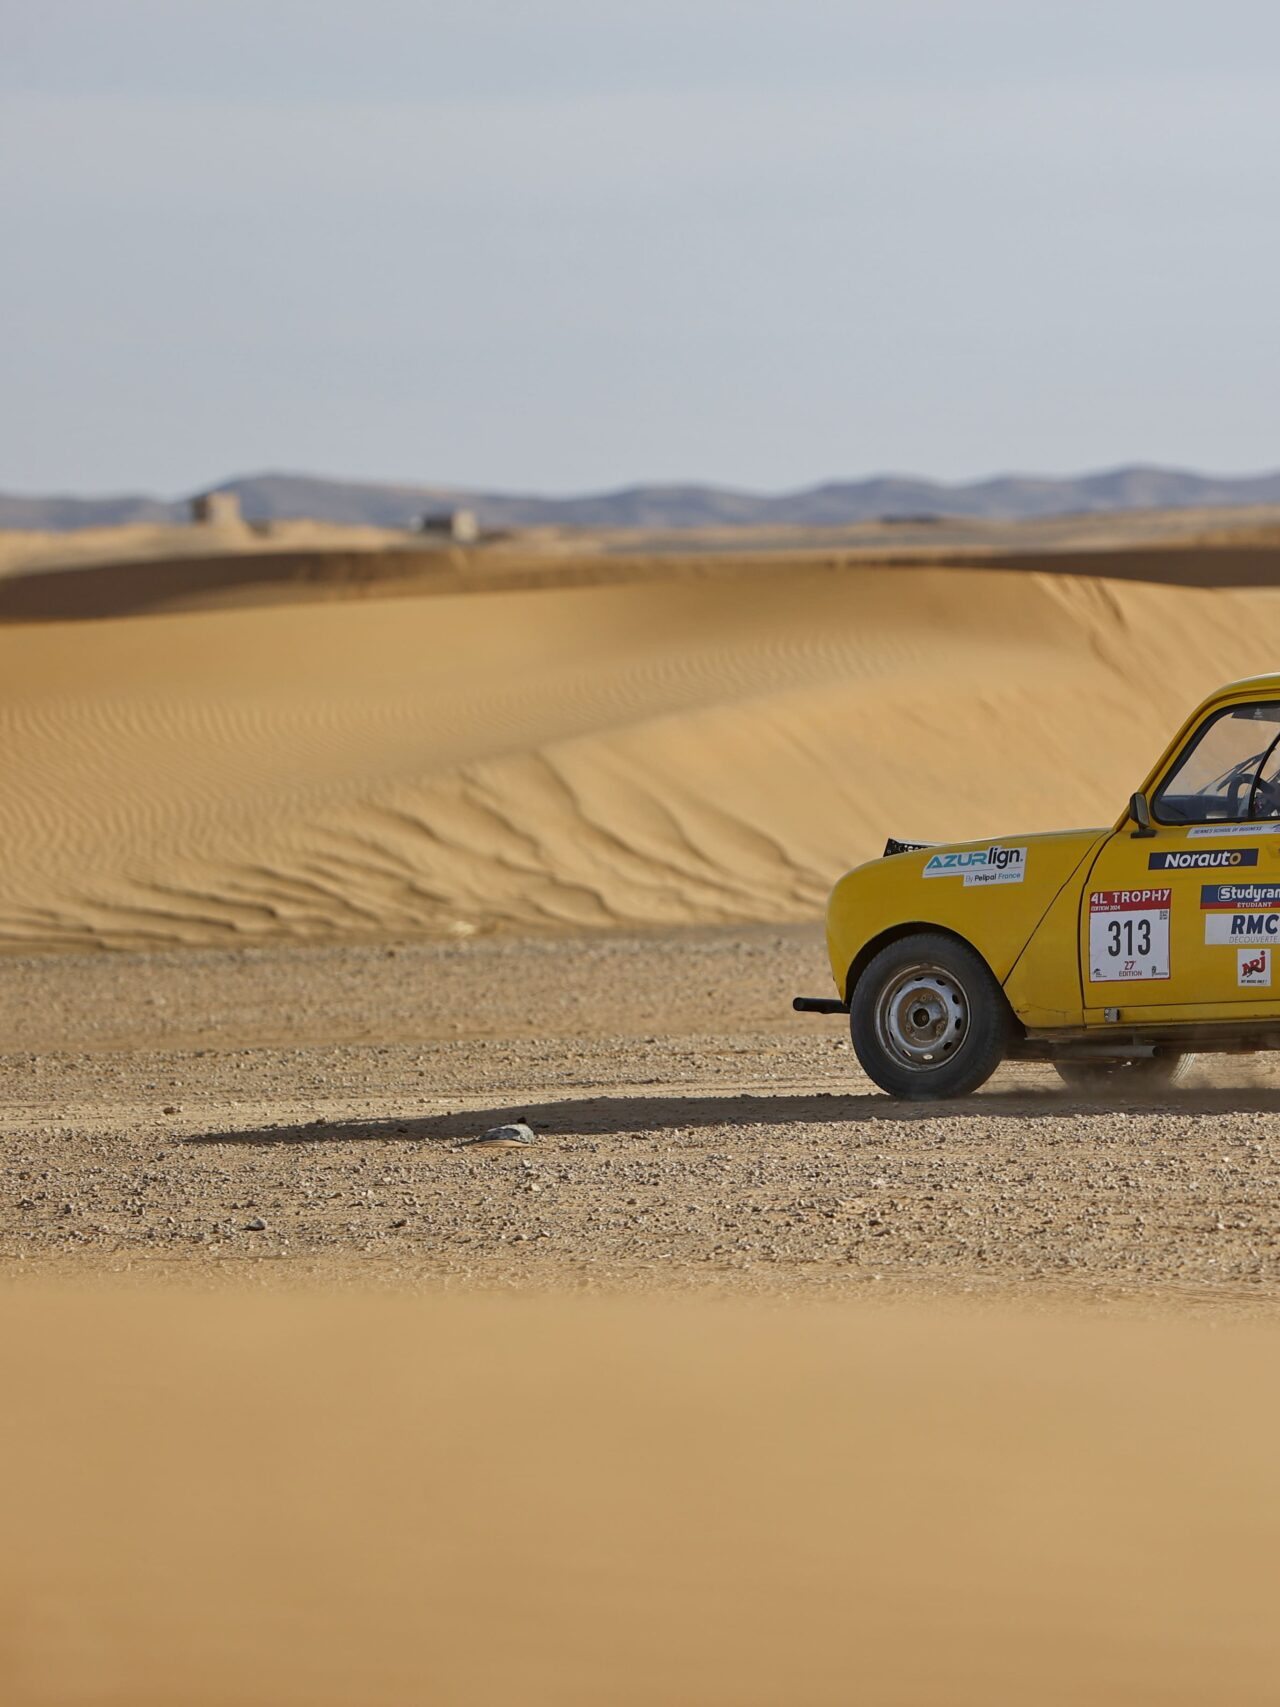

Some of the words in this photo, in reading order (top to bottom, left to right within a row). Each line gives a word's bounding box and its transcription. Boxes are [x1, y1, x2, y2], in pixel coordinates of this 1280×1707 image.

[1165, 851, 1242, 868] Norauto
[975, 873, 997, 883] Pelipal
[998, 872, 1021, 880] France
[1091, 892, 1107, 904] 4L
[1113, 889, 1170, 904] TROPHY
[1231, 914, 1280, 935] RMC
[1108, 919, 1151, 957] 313
[1229, 935, 1278, 944] DÉCOUVERTE
